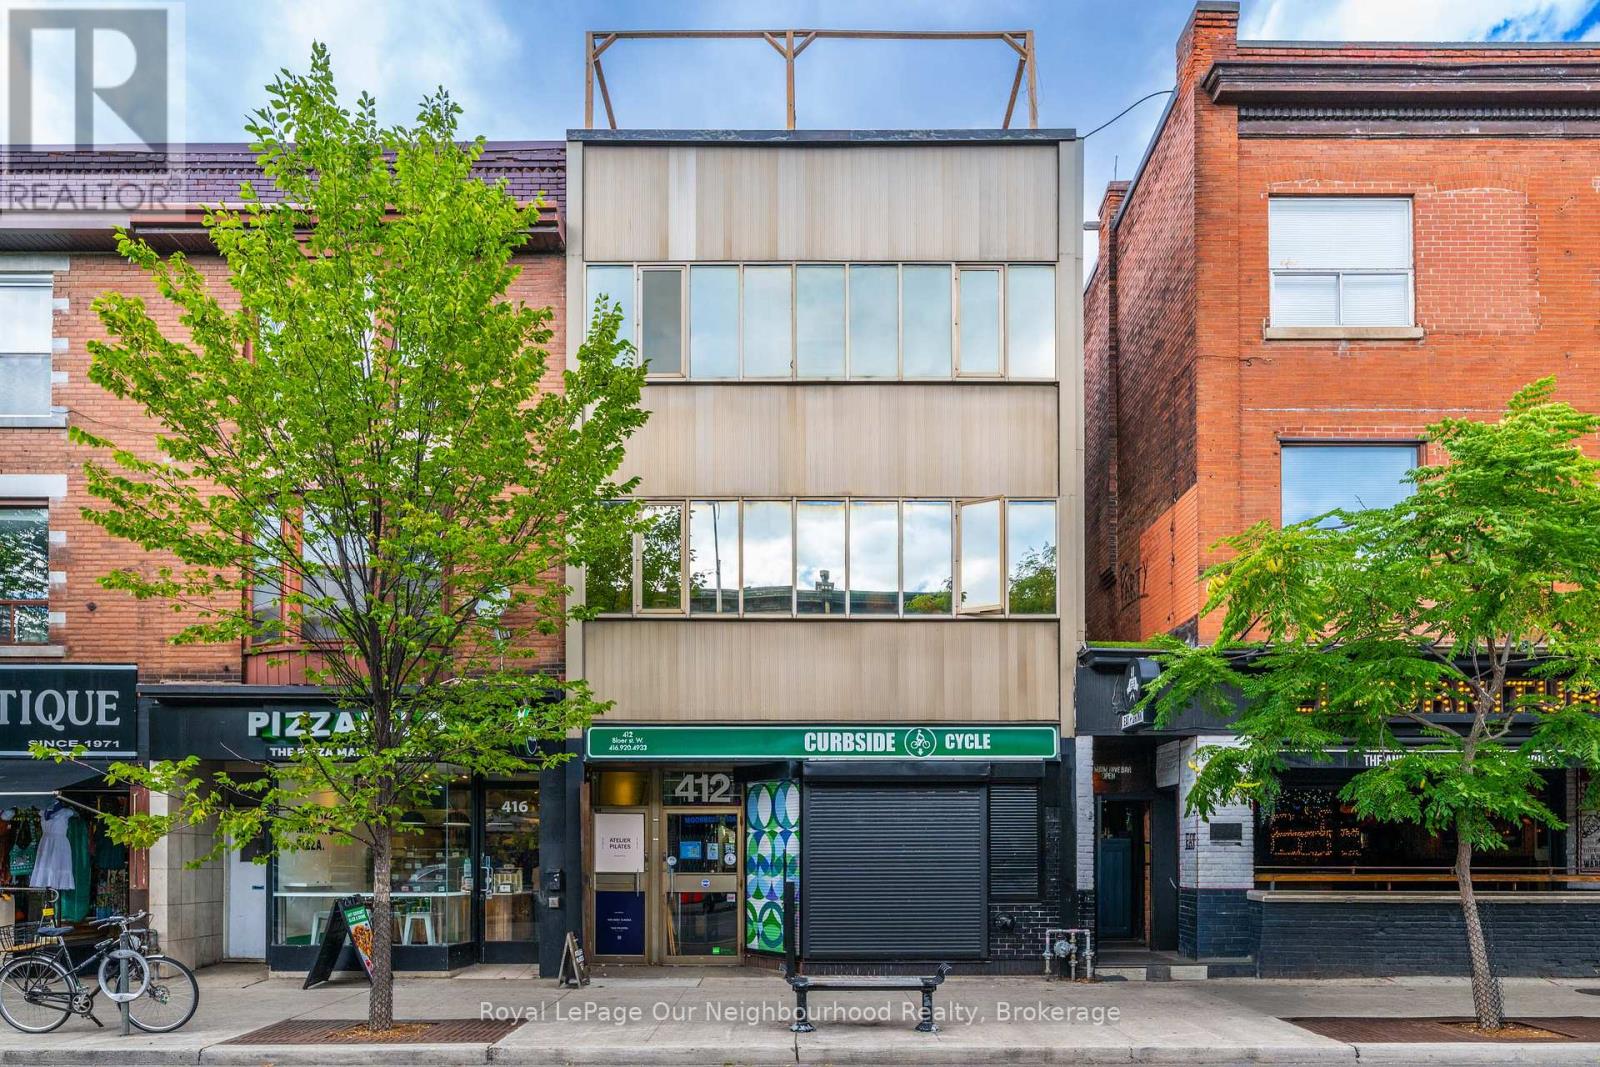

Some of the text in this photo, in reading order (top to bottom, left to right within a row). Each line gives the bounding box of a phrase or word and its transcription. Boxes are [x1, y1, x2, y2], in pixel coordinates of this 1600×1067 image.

[28, 739, 120, 748] SINCE 1971
[804, 732, 991, 752] CURBSIDE CYCLE
[269, 747, 295, 757] THE
[675, 773, 731, 803] 412
[501, 800, 529, 813] 416
